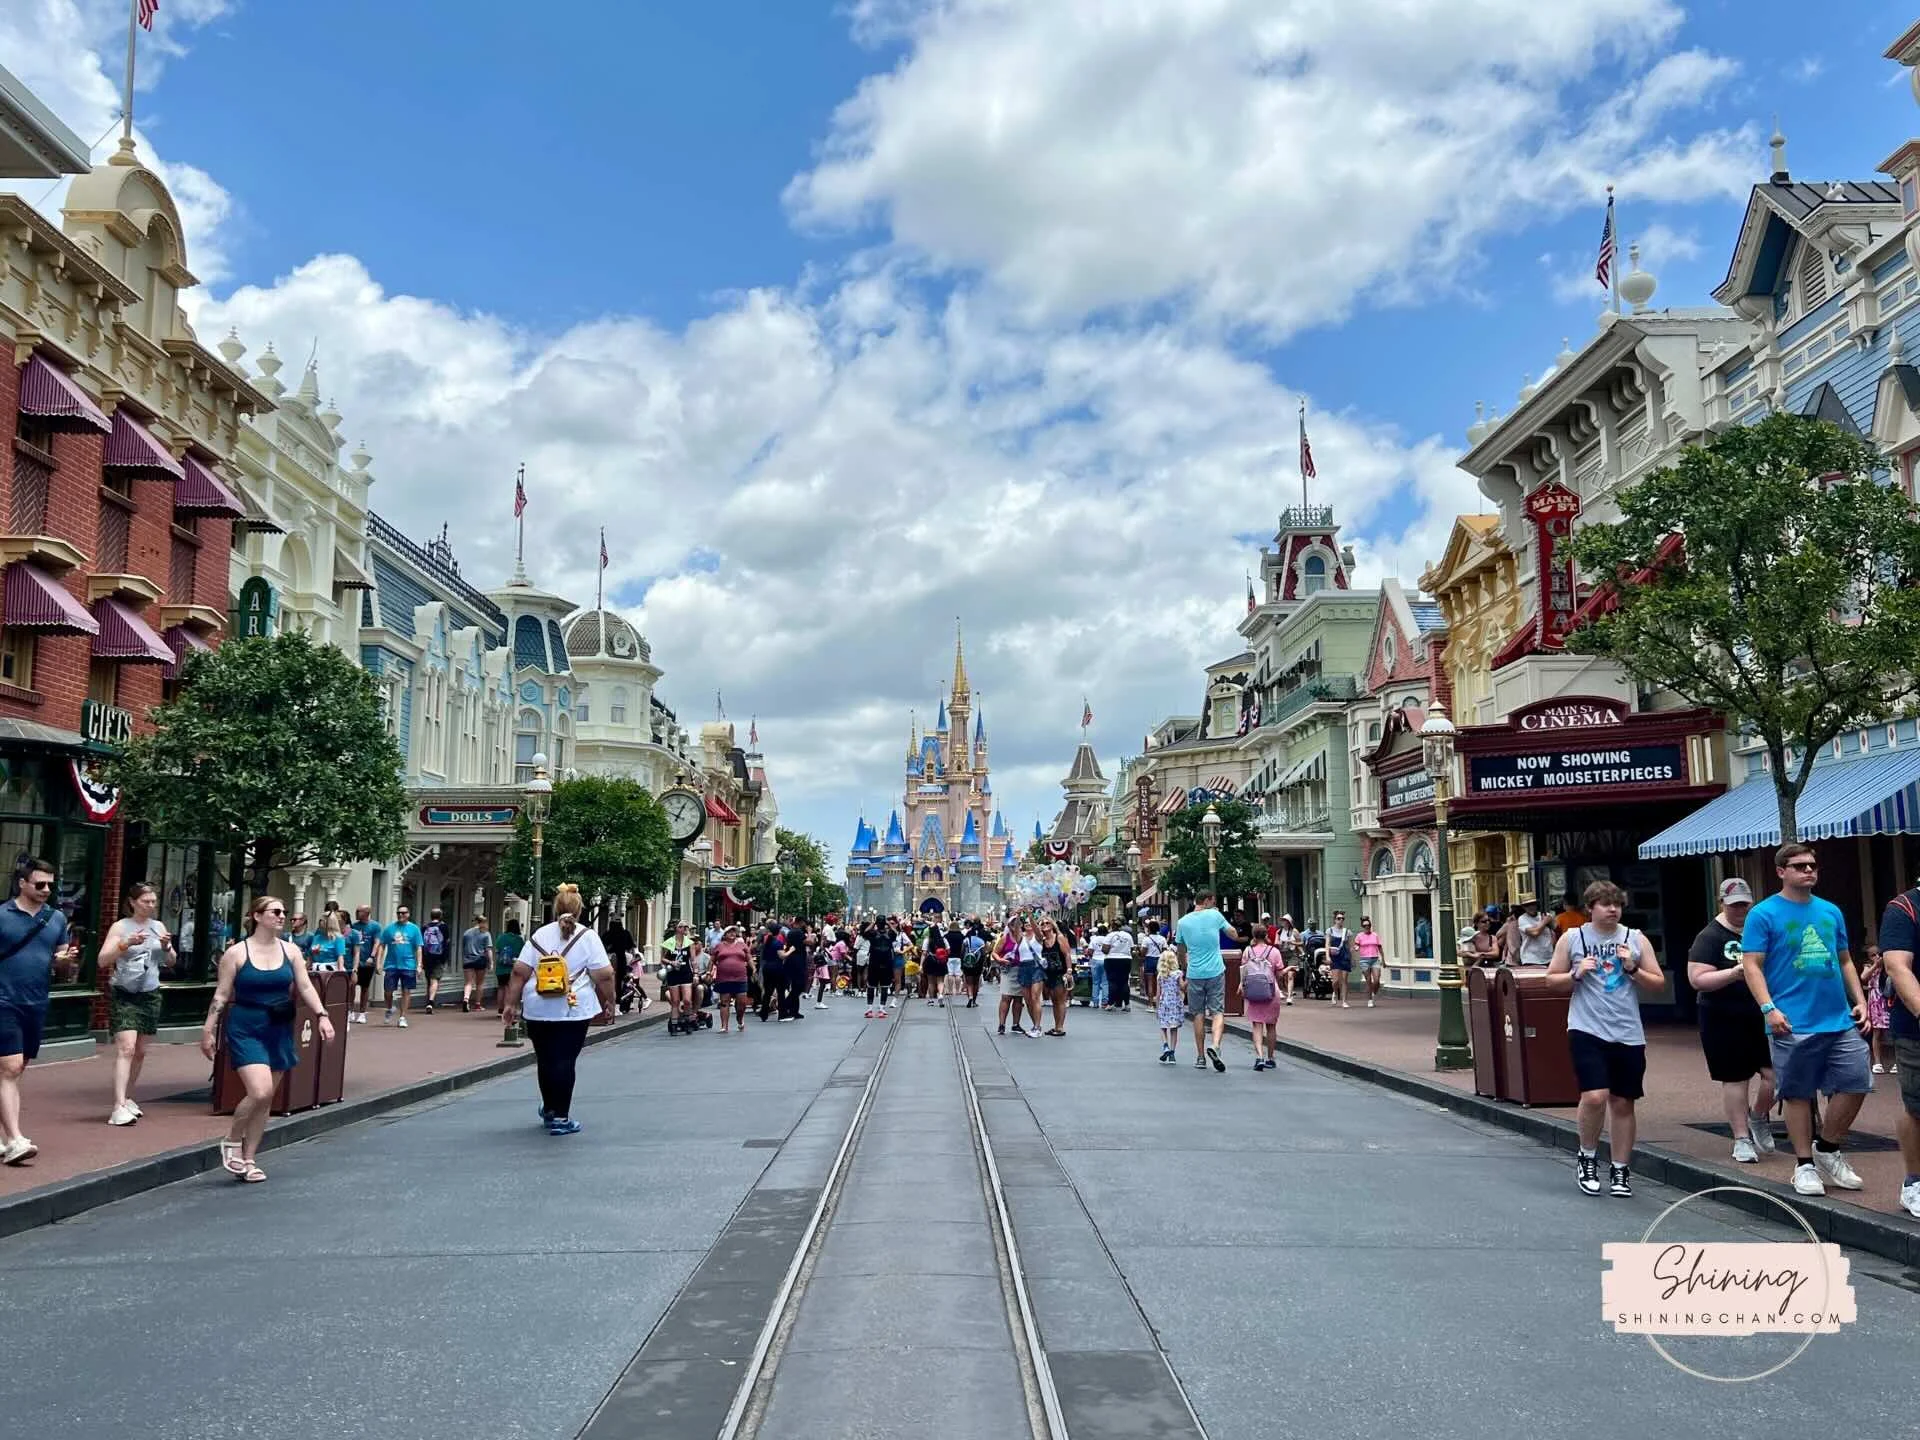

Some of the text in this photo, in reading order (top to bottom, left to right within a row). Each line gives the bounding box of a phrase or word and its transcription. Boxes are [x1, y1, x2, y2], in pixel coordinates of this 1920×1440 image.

[1532, 495, 1573, 511] MAIN
[1521, 708, 1620, 730] CINEMA
[1545, 705, 1578, 717] MAIN
[88, 703, 133, 743] GIFTS
[1517, 751, 1631, 770] NOW SHOWING
[1481, 765, 1673, 790] MICKEY MOUSETERPIECES
[451, 812, 492, 822] DOLLS
